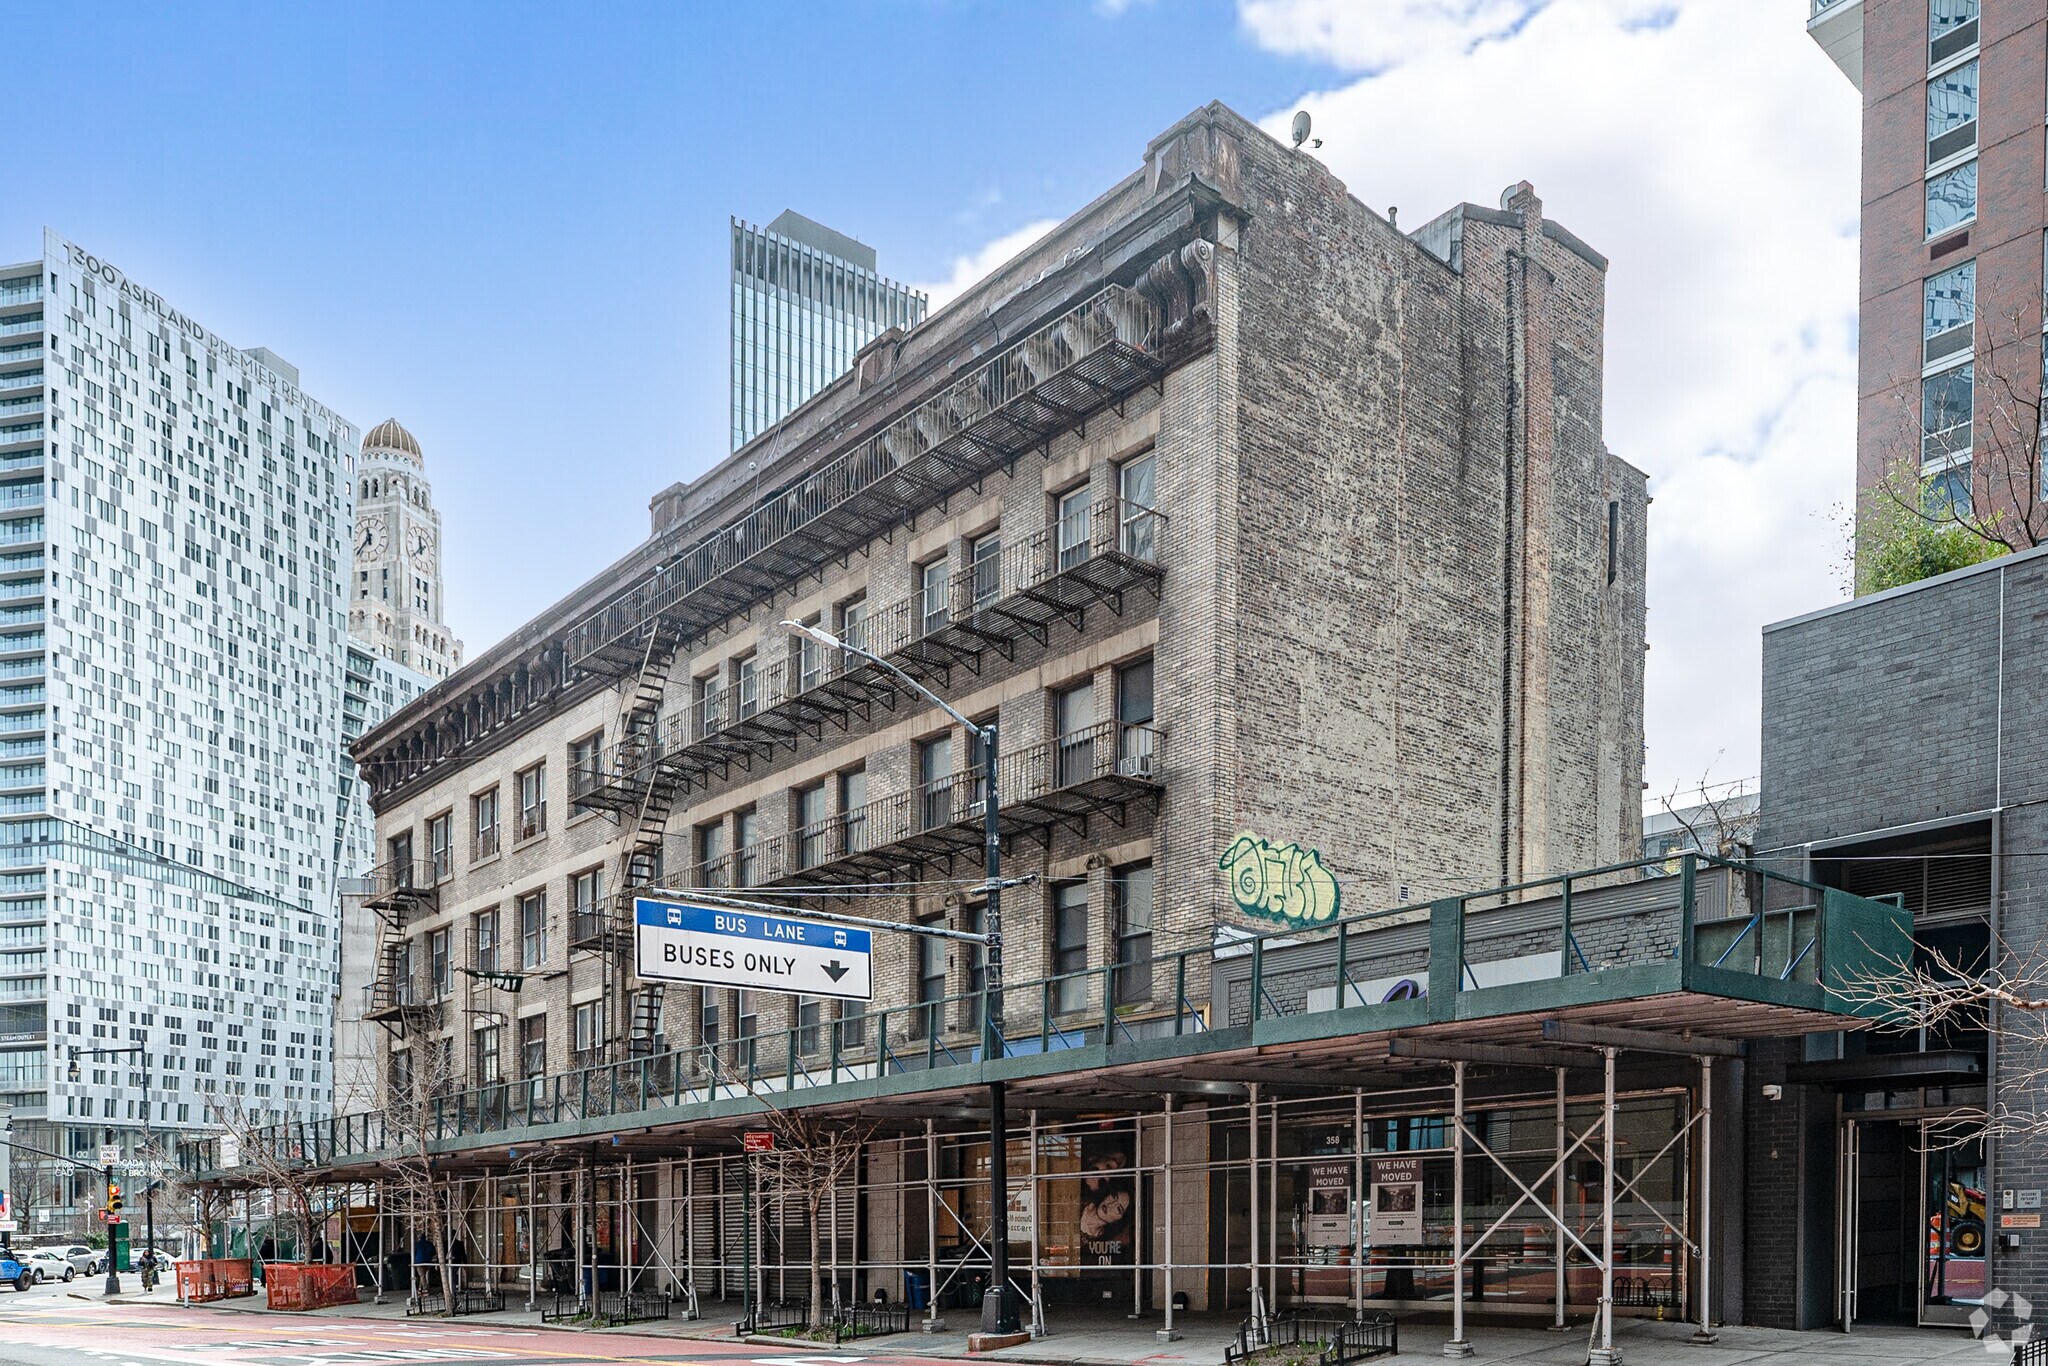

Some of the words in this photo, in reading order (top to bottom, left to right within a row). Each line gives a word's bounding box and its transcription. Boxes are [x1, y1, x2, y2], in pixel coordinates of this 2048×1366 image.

[73, 245, 116, 285] 300
[120, 278, 205, 340] ASHLAND
[209, 333, 277, 390] PREMIER
[281, 380, 343, 426] RENTALS
[714, 915, 747, 934] BUS
[764, 921, 805, 941] LANE
[664, 943, 735, 969] BUSES
[744, 953, 796, 976] ONLY
[1326, 1136, 1340, 1145] 358
[1377, 1161, 1391, 1170] WE
[1393, 1160, 1417, 1169] HAVE
[1312, 1167, 1325, 1175] WE
[1327, 1166, 1348, 1175] HAVE
[1316, 1177, 1344, 1186] MOVED
[1381, 1172, 1412, 1181] MOVED
[1088, 1240, 1122, 1254] YOU'RE
[1098, 1255, 1112, 1266] ON
